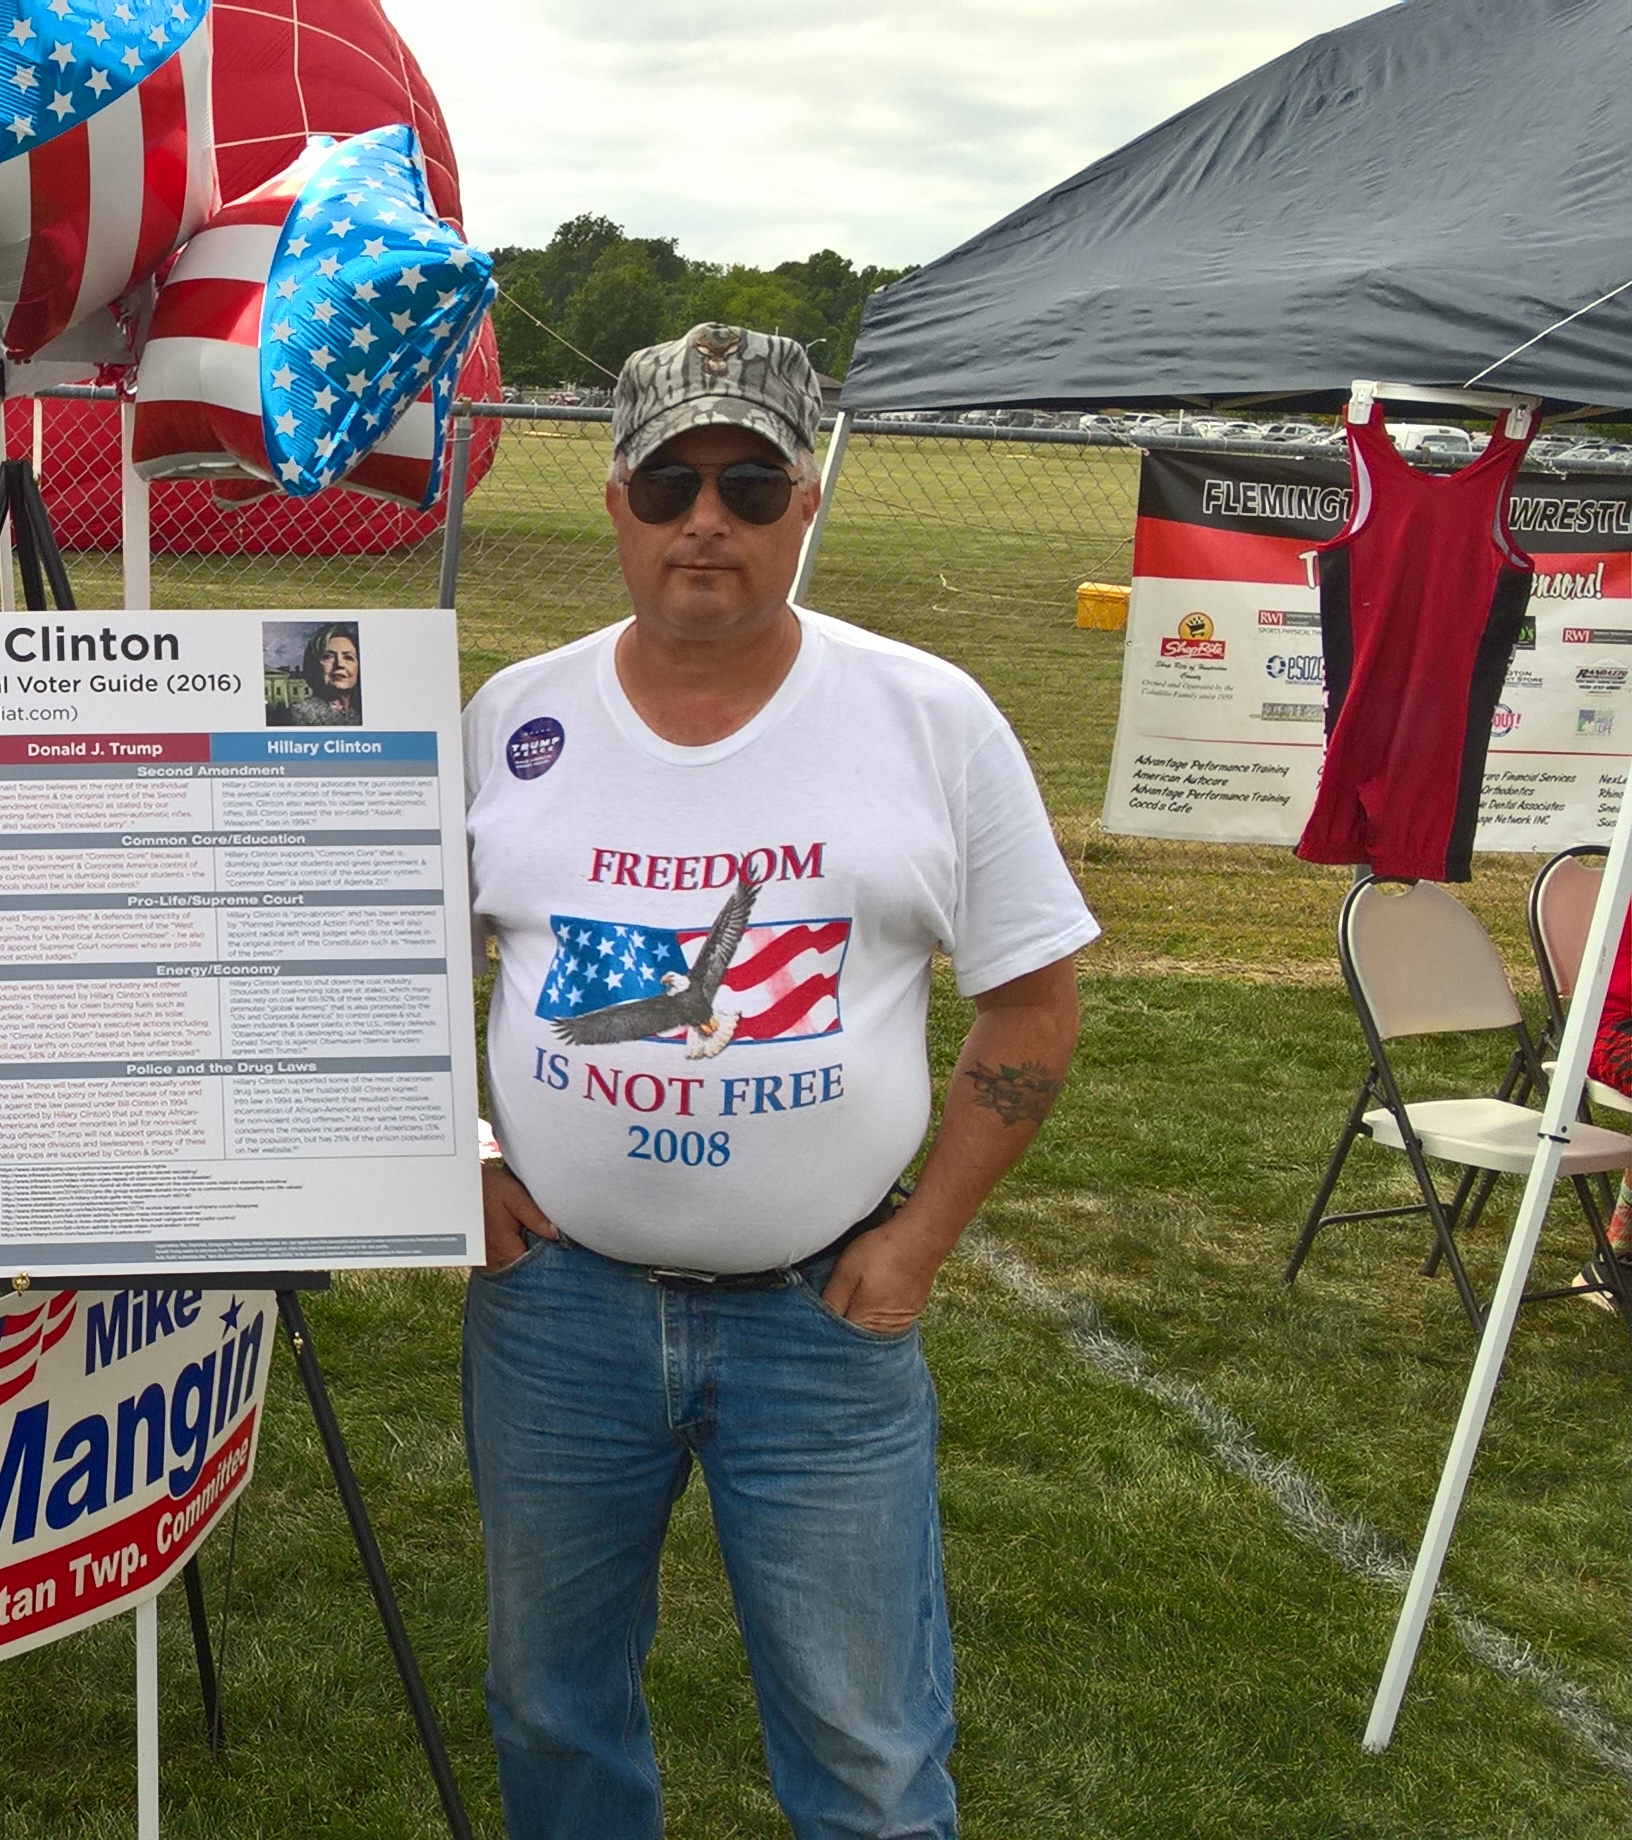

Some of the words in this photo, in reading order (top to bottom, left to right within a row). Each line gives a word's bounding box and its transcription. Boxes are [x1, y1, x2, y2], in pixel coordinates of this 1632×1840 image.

[1260, 611, 1283, 626] RWJ
[1564, 629, 1590, 643] RWJ
[4, 626, 179, 663] Clinton
[1164, 640, 1224, 658] ShopRite
[17, 675, 81, 693] Voter
[90, 674, 158, 692] Guide
[167, 673, 242, 694] (2016)
[28, 742, 86, 757] Donald
[91, 743, 105, 756] J.
[109, 742, 163, 757] Trump
[267, 740, 319, 756] Hillary
[324, 740, 382, 754] Clinton
[511, 736, 560, 752] TRUMP
[137, 766, 193, 777] Second
[197, 765, 285, 777] Amendment
[1134, 755, 1188, 770] Advantage
[1252, 763, 1290, 777] Training
[1132, 769, 1180, 784] American
[1183, 773, 1229, 787] Autocare
[1501, 771, 1539, 782] Financial
[1539, 772, 1577, 782] Services
[1131, 784, 1184, 799] Advantage
[1186, 788, 1251, 802] Performance
[1252, 792, 1291, 806] Training
[1481, 785, 1535, 796] Orthodontics
[1128, 797, 1166, 811] Cocco's
[1168, 801, 1193, 813] Cafe
[1488, 799, 1517, 809] Dental
[1517, 800, 1566, 811] Associates
[1494, 814, 1532, 824] Network
[1533, 815, 1550, 825] INC
[121, 835, 187, 847] Common
[192, 833, 306, 846] Core/Education
[588, 842, 827, 891] FREEDOM
[127, 894, 258, 908] Pro-Life/Supreme
[262, 894, 304, 905] Court
[156, 964, 281, 978] Energy/Economy
[126, 1064, 172, 1075] Police
[177, 1063, 205, 1074] and
[209, 1062, 234, 1073] the
[237, 1062, 274, 1075] Drug
[278, 1061, 317, 1072] Laws
[533, 1046, 569, 1090] IS
[583, 1063, 704, 1116] NOT
[719, 1063, 844, 1116] FREE
[627, 1125, 731, 1167] 2008
[85, 1290, 202, 1377] Mike
[69, 1542, 147, 1598] Twp.
[156, 1435, 249, 1554] Committee
